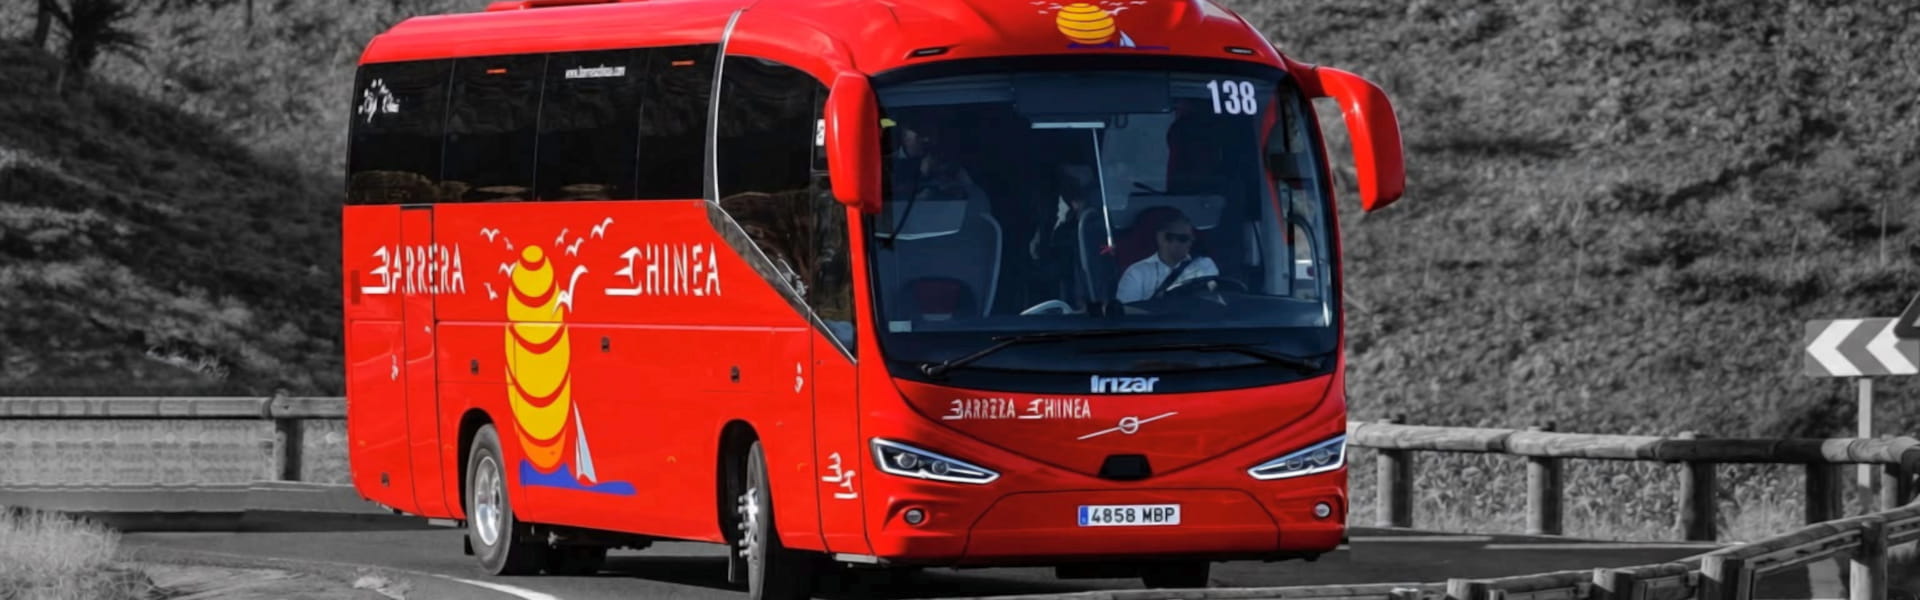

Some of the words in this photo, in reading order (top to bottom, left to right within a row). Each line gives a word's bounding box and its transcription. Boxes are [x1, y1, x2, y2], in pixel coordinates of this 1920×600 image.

[1206, 79, 1258, 115] 138
[361, 243, 466, 294] BARRERA
[604, 243, 721, 297] CHINEA
[1090, 374, 1160, 393] Irizar
[942, 398, 1016, 420] BARRERA
[1017, 398, 1092, 420] CHINEA
[1091, 507, 1136, 523] 4858
[1142, 506, 1175, 522] MBP
